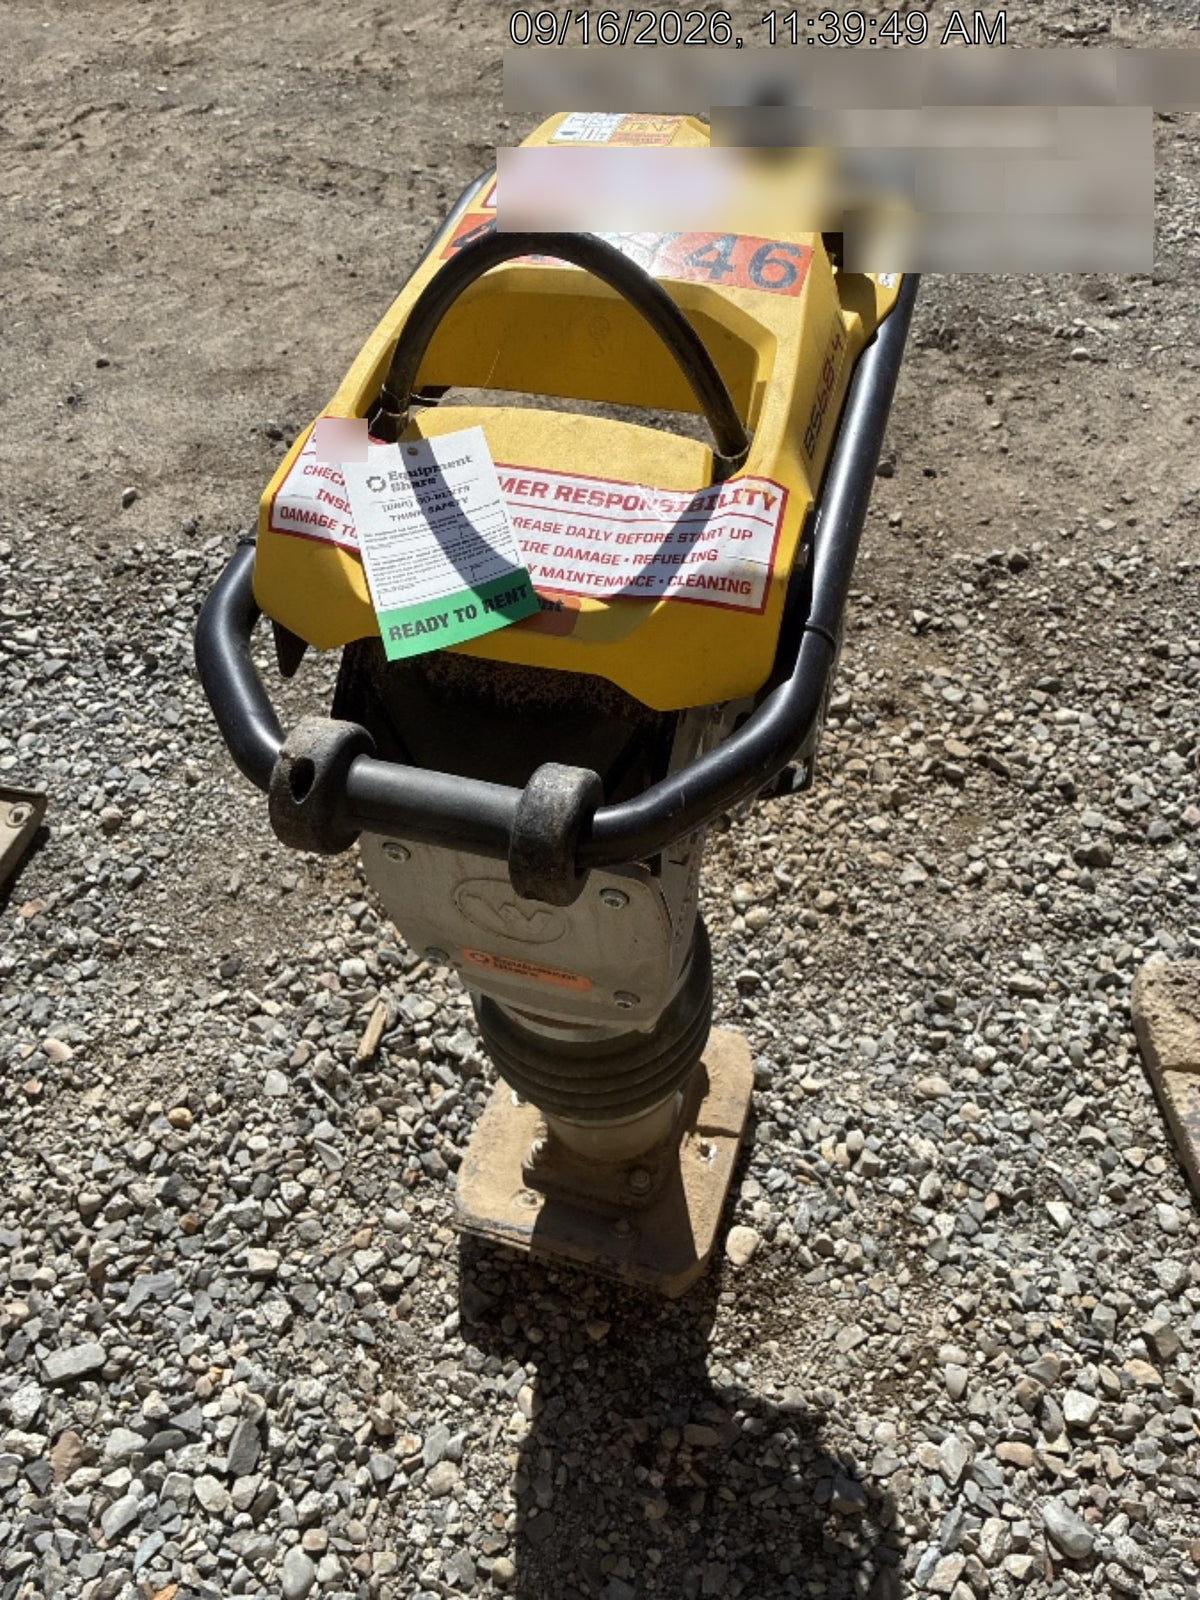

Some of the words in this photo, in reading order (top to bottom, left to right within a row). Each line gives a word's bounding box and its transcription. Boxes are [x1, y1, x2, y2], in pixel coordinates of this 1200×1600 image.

[388, 454, 473, 482] Equipment
[390, 475, 437, 493] Share
[427, 496, 469, 514] SAFETY
[554, 485, 778, 513] RESPONSIBILITY
[511, 516, 563, 535] REASE
[565, 525, 612, 541] DAILY
[615, 532, 674, 545] BEFORE
[677, 526, 727, 543] START
[730, 527, 753, 541] UP
[280, 506, 338, 531] DAMAGE
[540, 566, 656, 587] MAINTENANCE
[667, 573, 752, 595] CLEANING
[553, 545, 622, 566] DAMAGE
[632, 548, 718, 565] REFUELING
[388, 612, 448, 641] READY
[453, 604, 477, 623] TO
[482, 585, 527, 614] RENT
